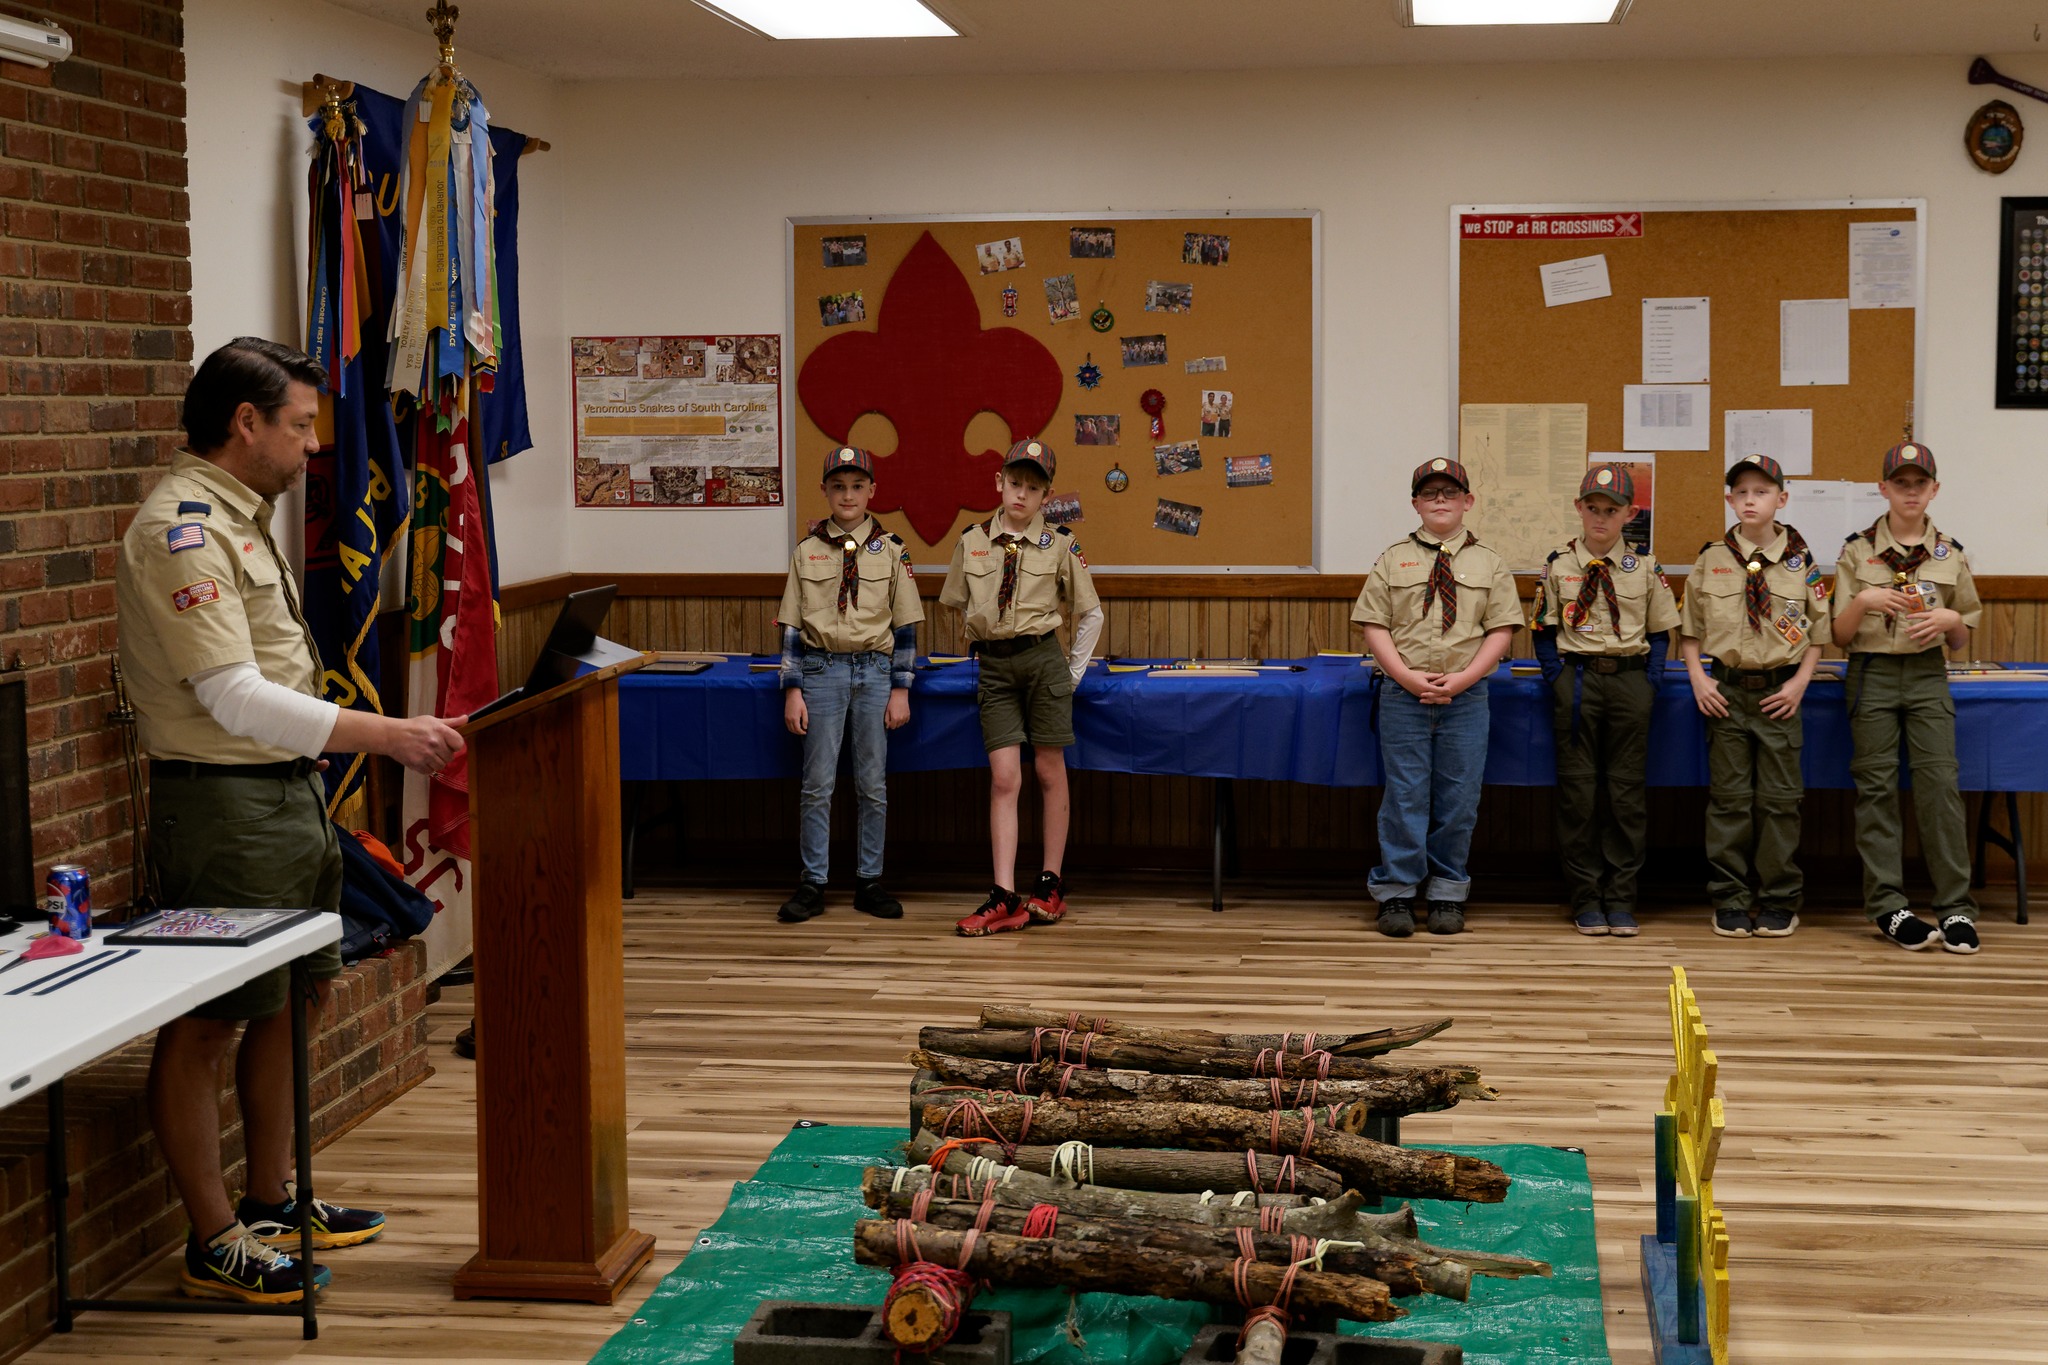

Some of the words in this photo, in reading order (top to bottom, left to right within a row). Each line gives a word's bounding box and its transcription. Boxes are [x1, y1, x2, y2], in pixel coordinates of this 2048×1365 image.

[437, 180, 445, 212] JOURNEY
[437, 215, 445, 225] TO
[1464, 222, 1480, 234] we
[1484, 220, 1514, 234] STOP
[1517, 221, 1529, 234] at
[1532, 220, 1548, 234] RR
[1551, 219, 1615, 234] CROSSINGS
[437, 226, 445, 273] EXCELLENCE
[318, 286, 327, 324] CAMPOREE
[316, 326, 324, 344] FIRST
[400, 319, 411, 349] PATROL
[584, 403, 637, 413] Venomous
[639, 403, 675, 413] Snakes
[678, 403, 688, 412] of
[690, 402, 721, 412] South
[723, 402, 767, 412] Carolina
[199, 594, 213, 602] 2021
[1815, 582, 1825, 598] 21
